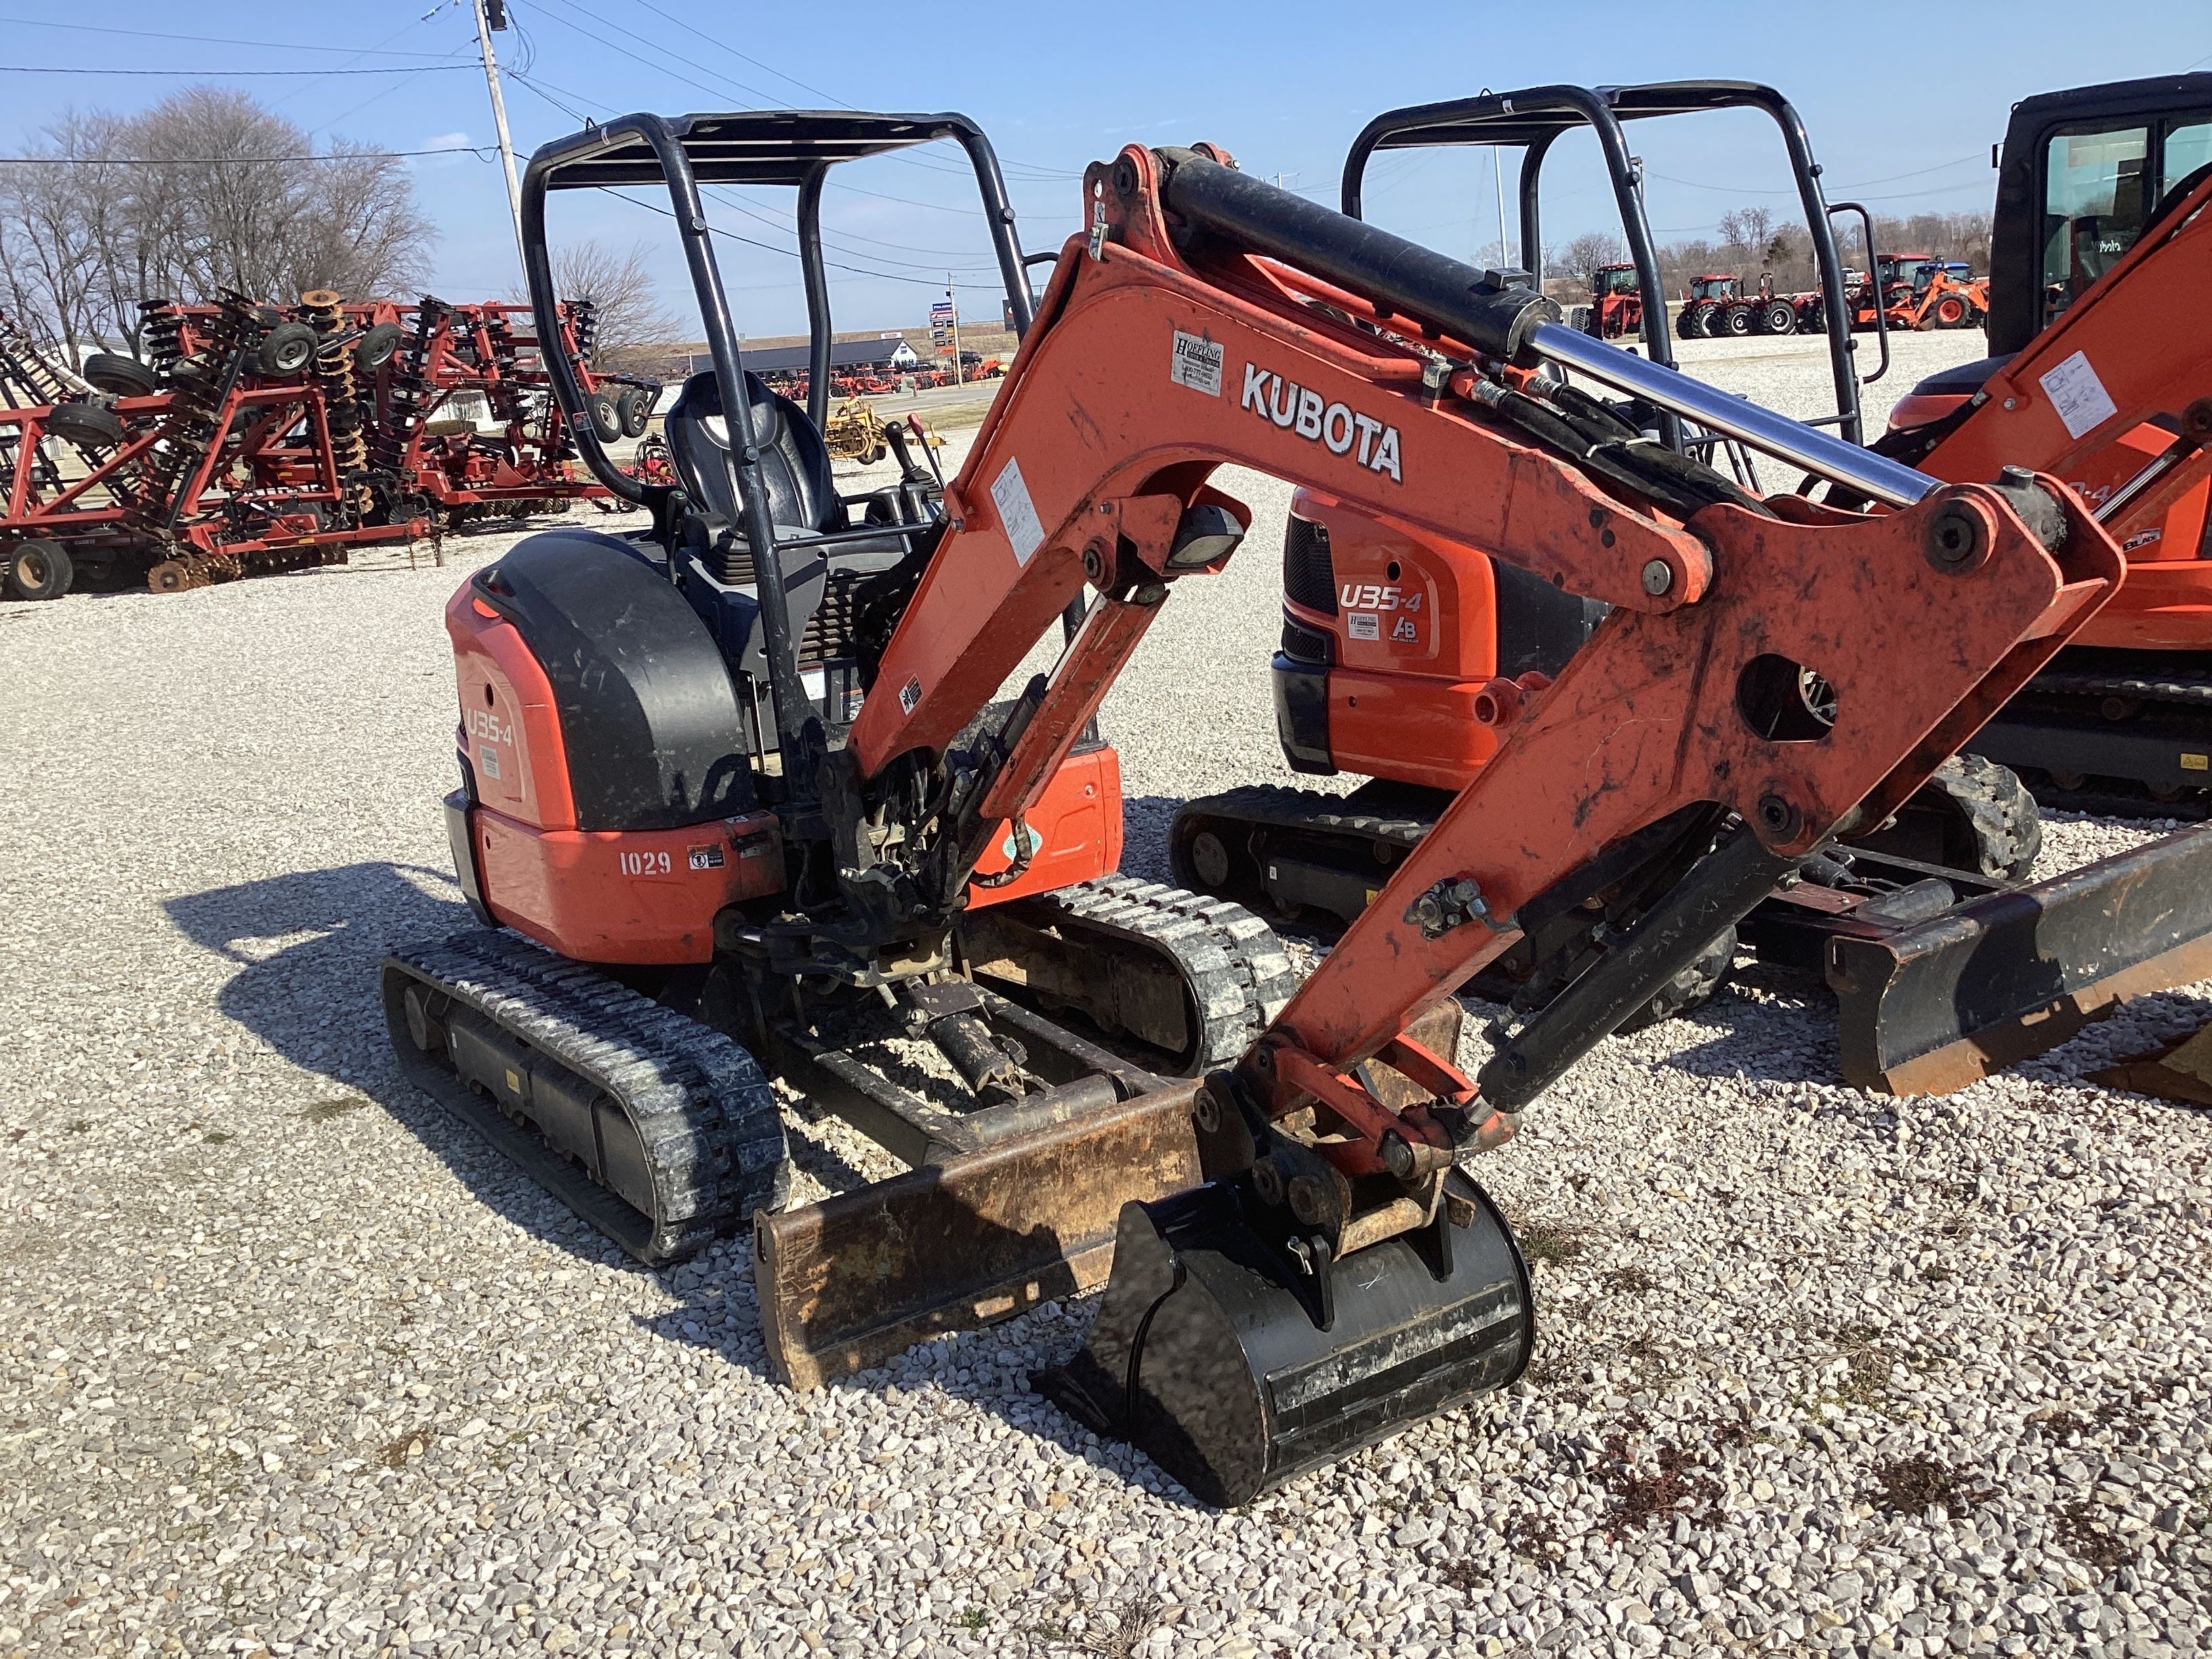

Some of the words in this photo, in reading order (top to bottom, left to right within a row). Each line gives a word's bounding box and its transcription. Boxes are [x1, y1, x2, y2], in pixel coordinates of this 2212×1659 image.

[1241, 363, 1401, 483] KUBOTA
[1340, 584, 1422, 613] U35-4
[467, 708, 512, 747] U35-4
[619, 851, 672, 876] 1029
